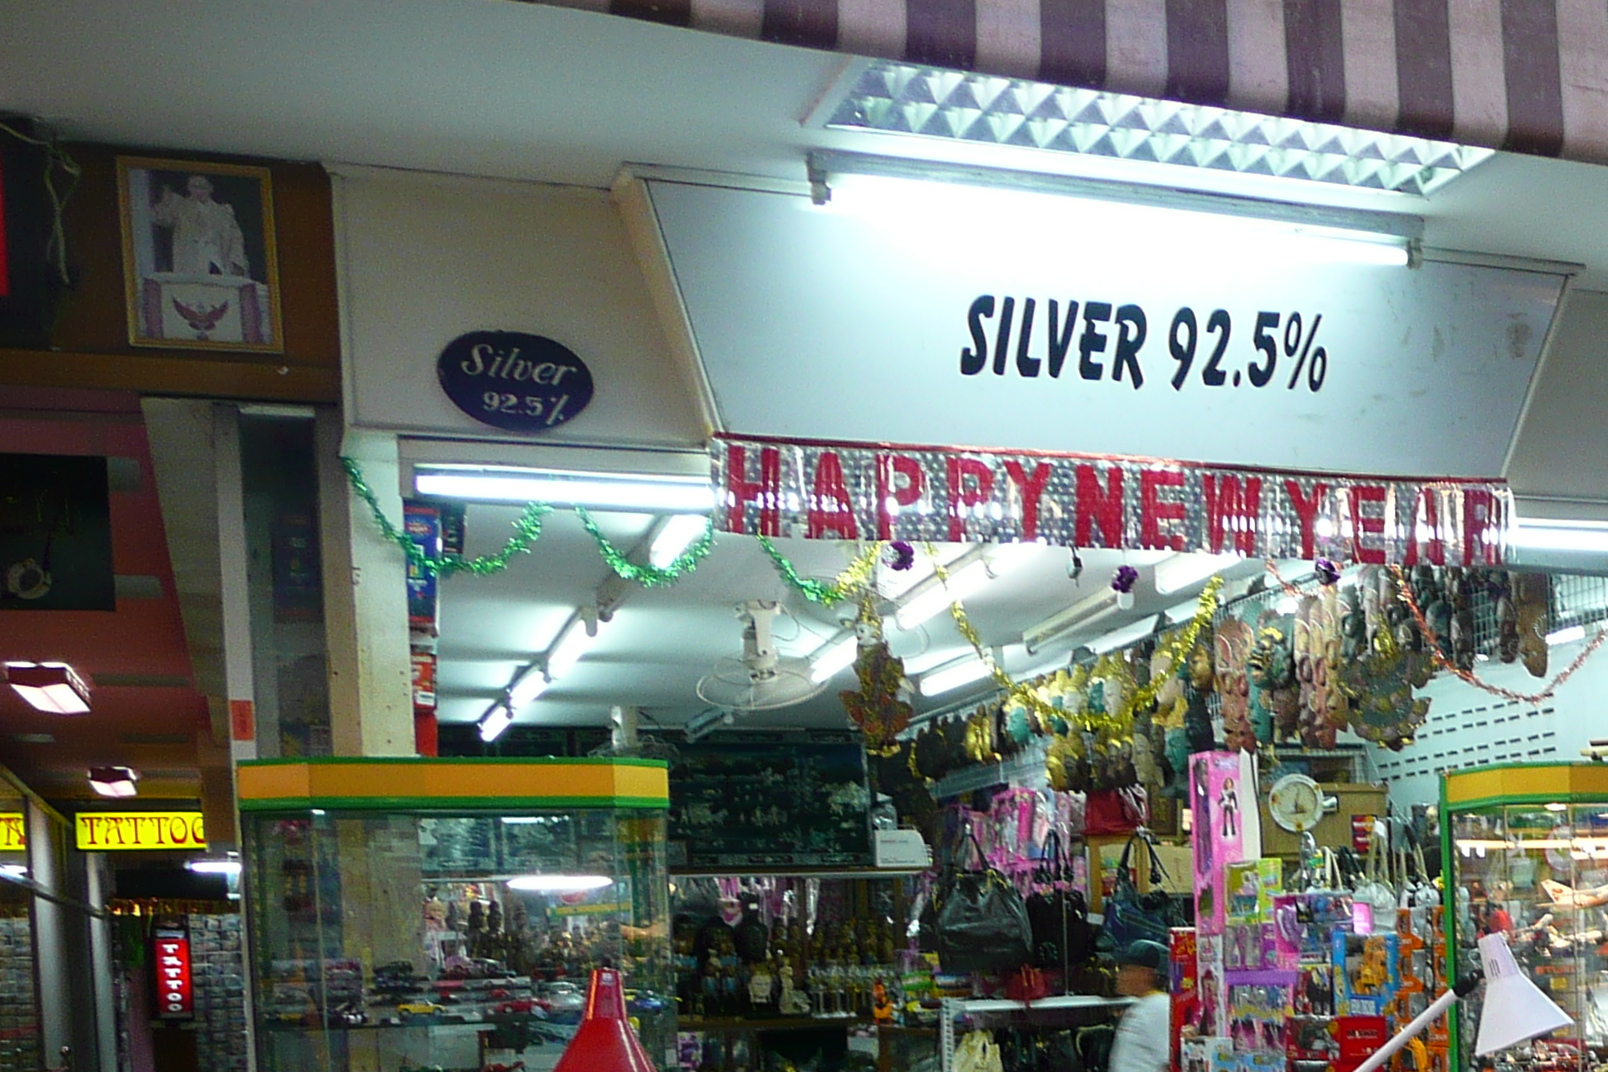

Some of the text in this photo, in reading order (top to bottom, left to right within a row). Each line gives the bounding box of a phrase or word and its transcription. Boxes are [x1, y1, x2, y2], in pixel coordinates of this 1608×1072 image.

[460, 343, 578, 386] Silver
[960, 293, 1329, 393] SILVER 92.5%
[482, 391, 570, 426] 92.5%
[727, 444, 1503, 568] HAPPY NEW YEAR
[161, 943, 184, 1012] TATTOO
